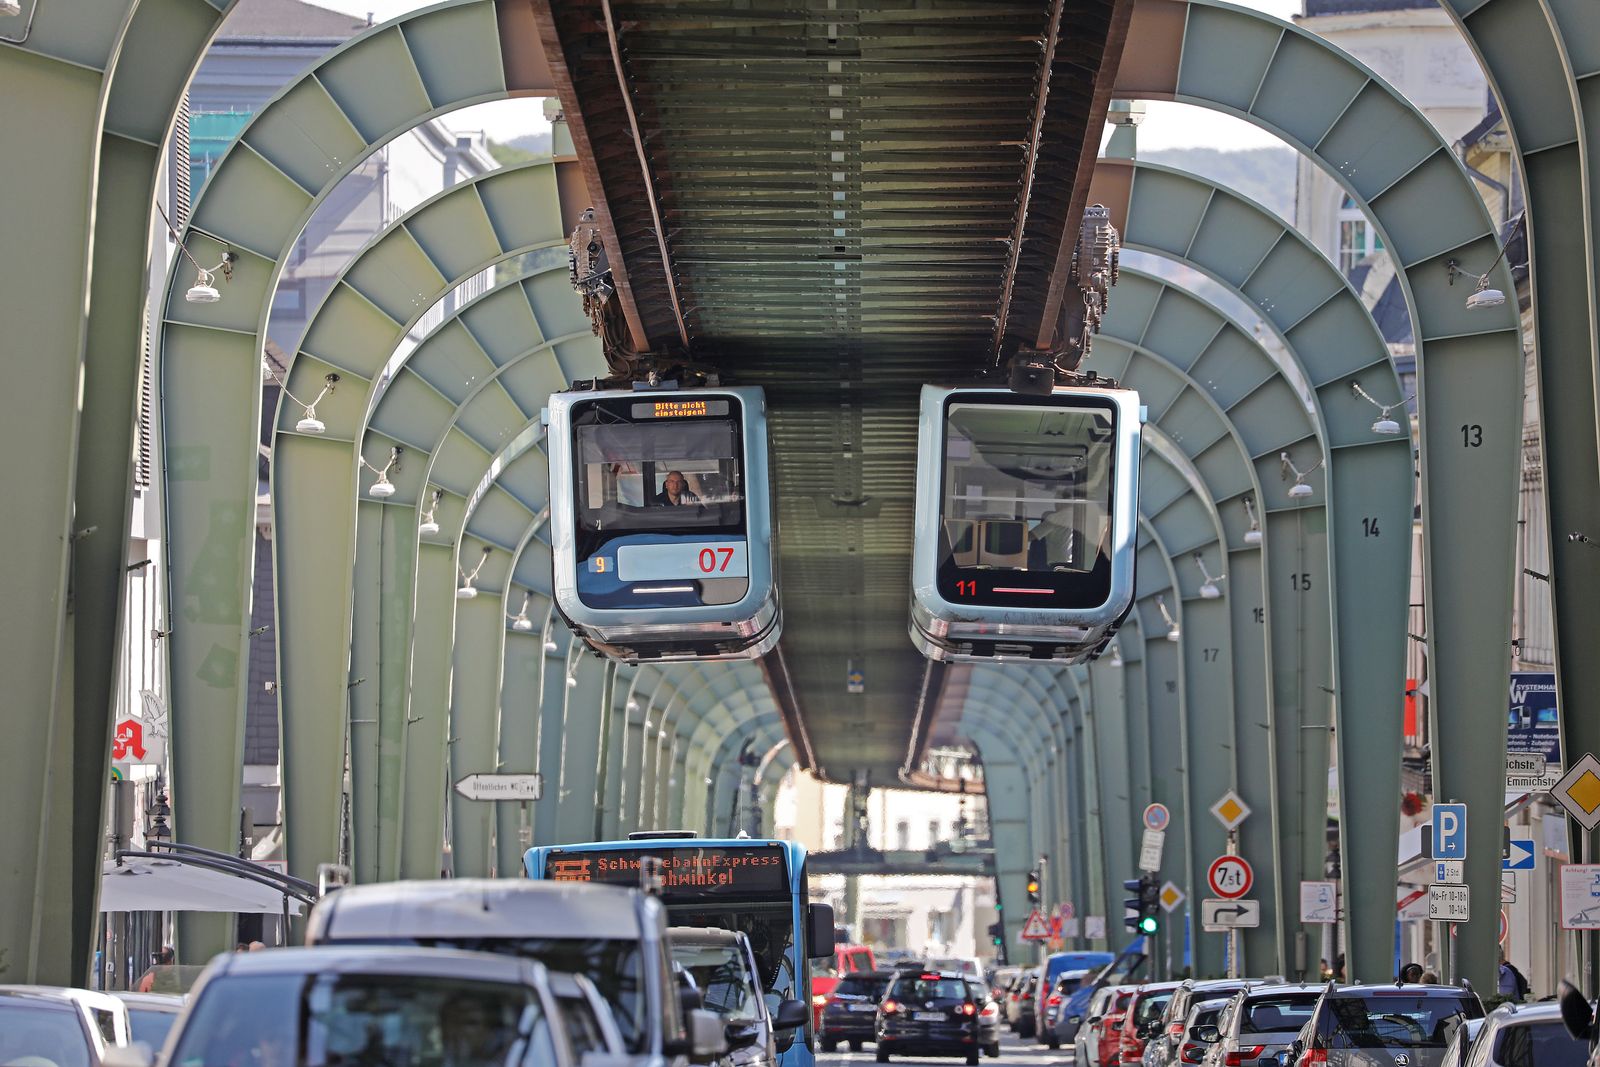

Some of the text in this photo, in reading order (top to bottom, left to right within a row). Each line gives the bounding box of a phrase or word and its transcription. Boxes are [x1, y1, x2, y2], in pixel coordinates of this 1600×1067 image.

[655, 409, 706, 417] einsteigen!
[682, 401, 706, 409] nicht
[1461, 424, 1483, 448] 13
[1362, 517, 1380, 537] 14
[595, 557, 605, 573] 9
[699, 547, 735, 573] 07
[955, 580, 977, 596] 11
[1290, 573, 1312, 591] 15
[1202, 647, 1220, 663] 17
[1440, 811, 1458, 852] P
[1431, 890, 1448, 901] Mo-Fr
[1431, 904, 1438, 914] Sa
